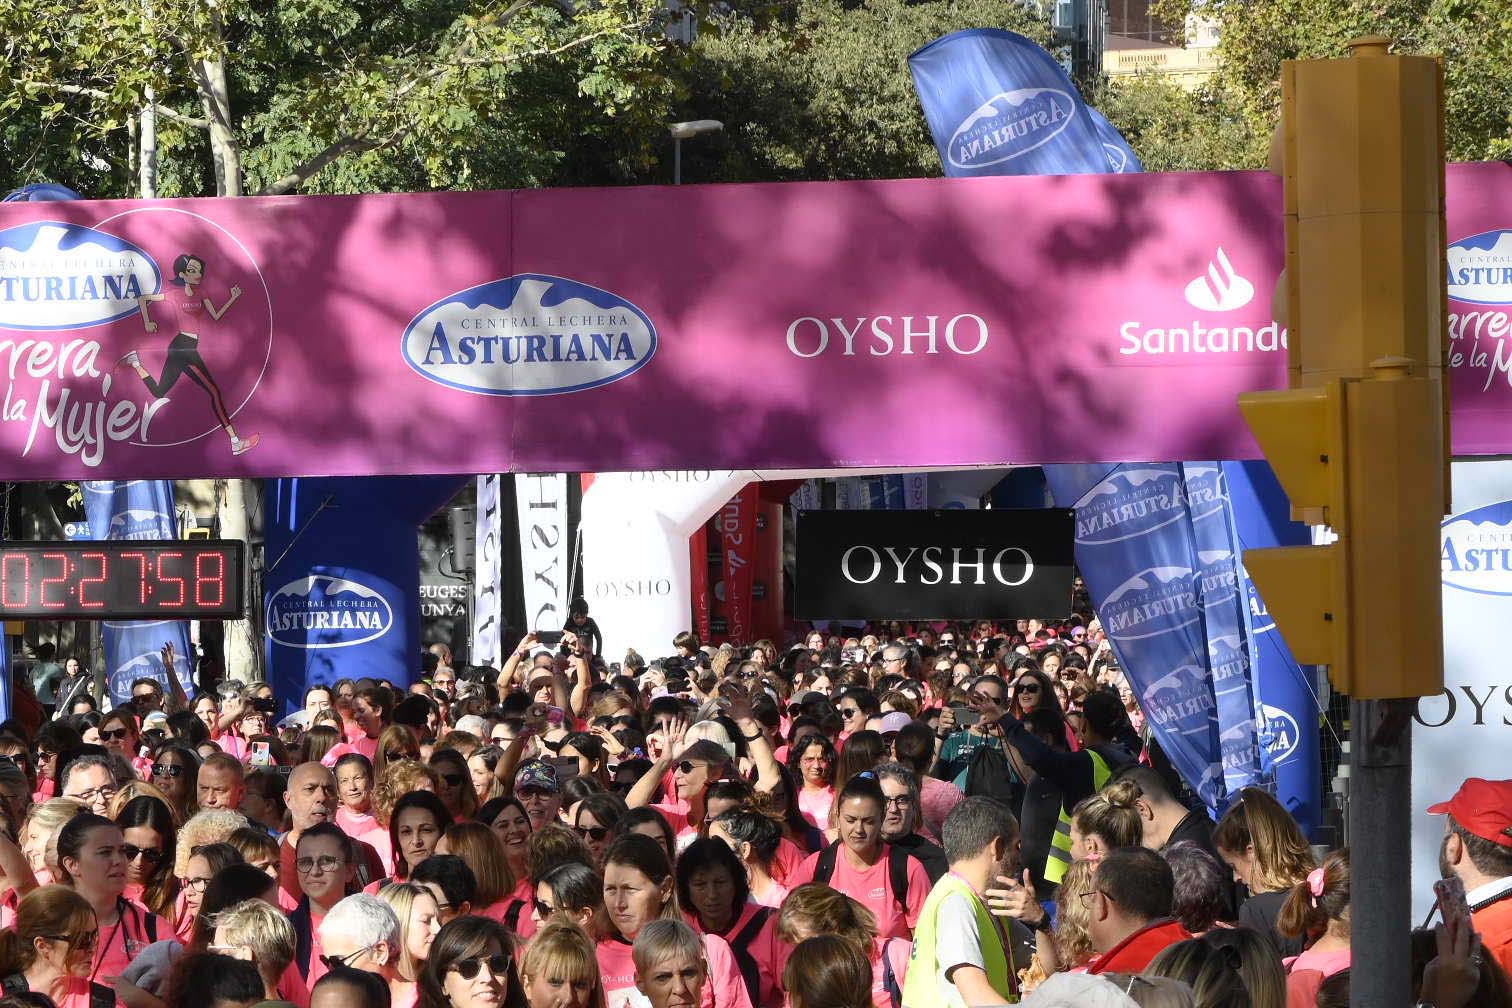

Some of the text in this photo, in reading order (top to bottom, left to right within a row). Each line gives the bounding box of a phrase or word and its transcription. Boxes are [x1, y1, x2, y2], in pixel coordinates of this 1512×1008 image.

[461, 314, 629, 330] CENTRAL LECHERA
[786, 313, 989, 358] OYSHO
[1119, 321, 1288, 355] Santand
[421, 321, 637, 365] ASTURIANA
[1469, 341, 1488, 368] la
[2, 382, 27, 422] la
[21, 374, 172, 467] Mujer
[0, 552, 225, 608] 02:27:58
[840, 545, 1034, 587] OYSHO
[329, 599, 378, 608] LECHERA
[595, 578, 672, 600] OYSHO
[271, 604, 383, 633] ASTURIANA
